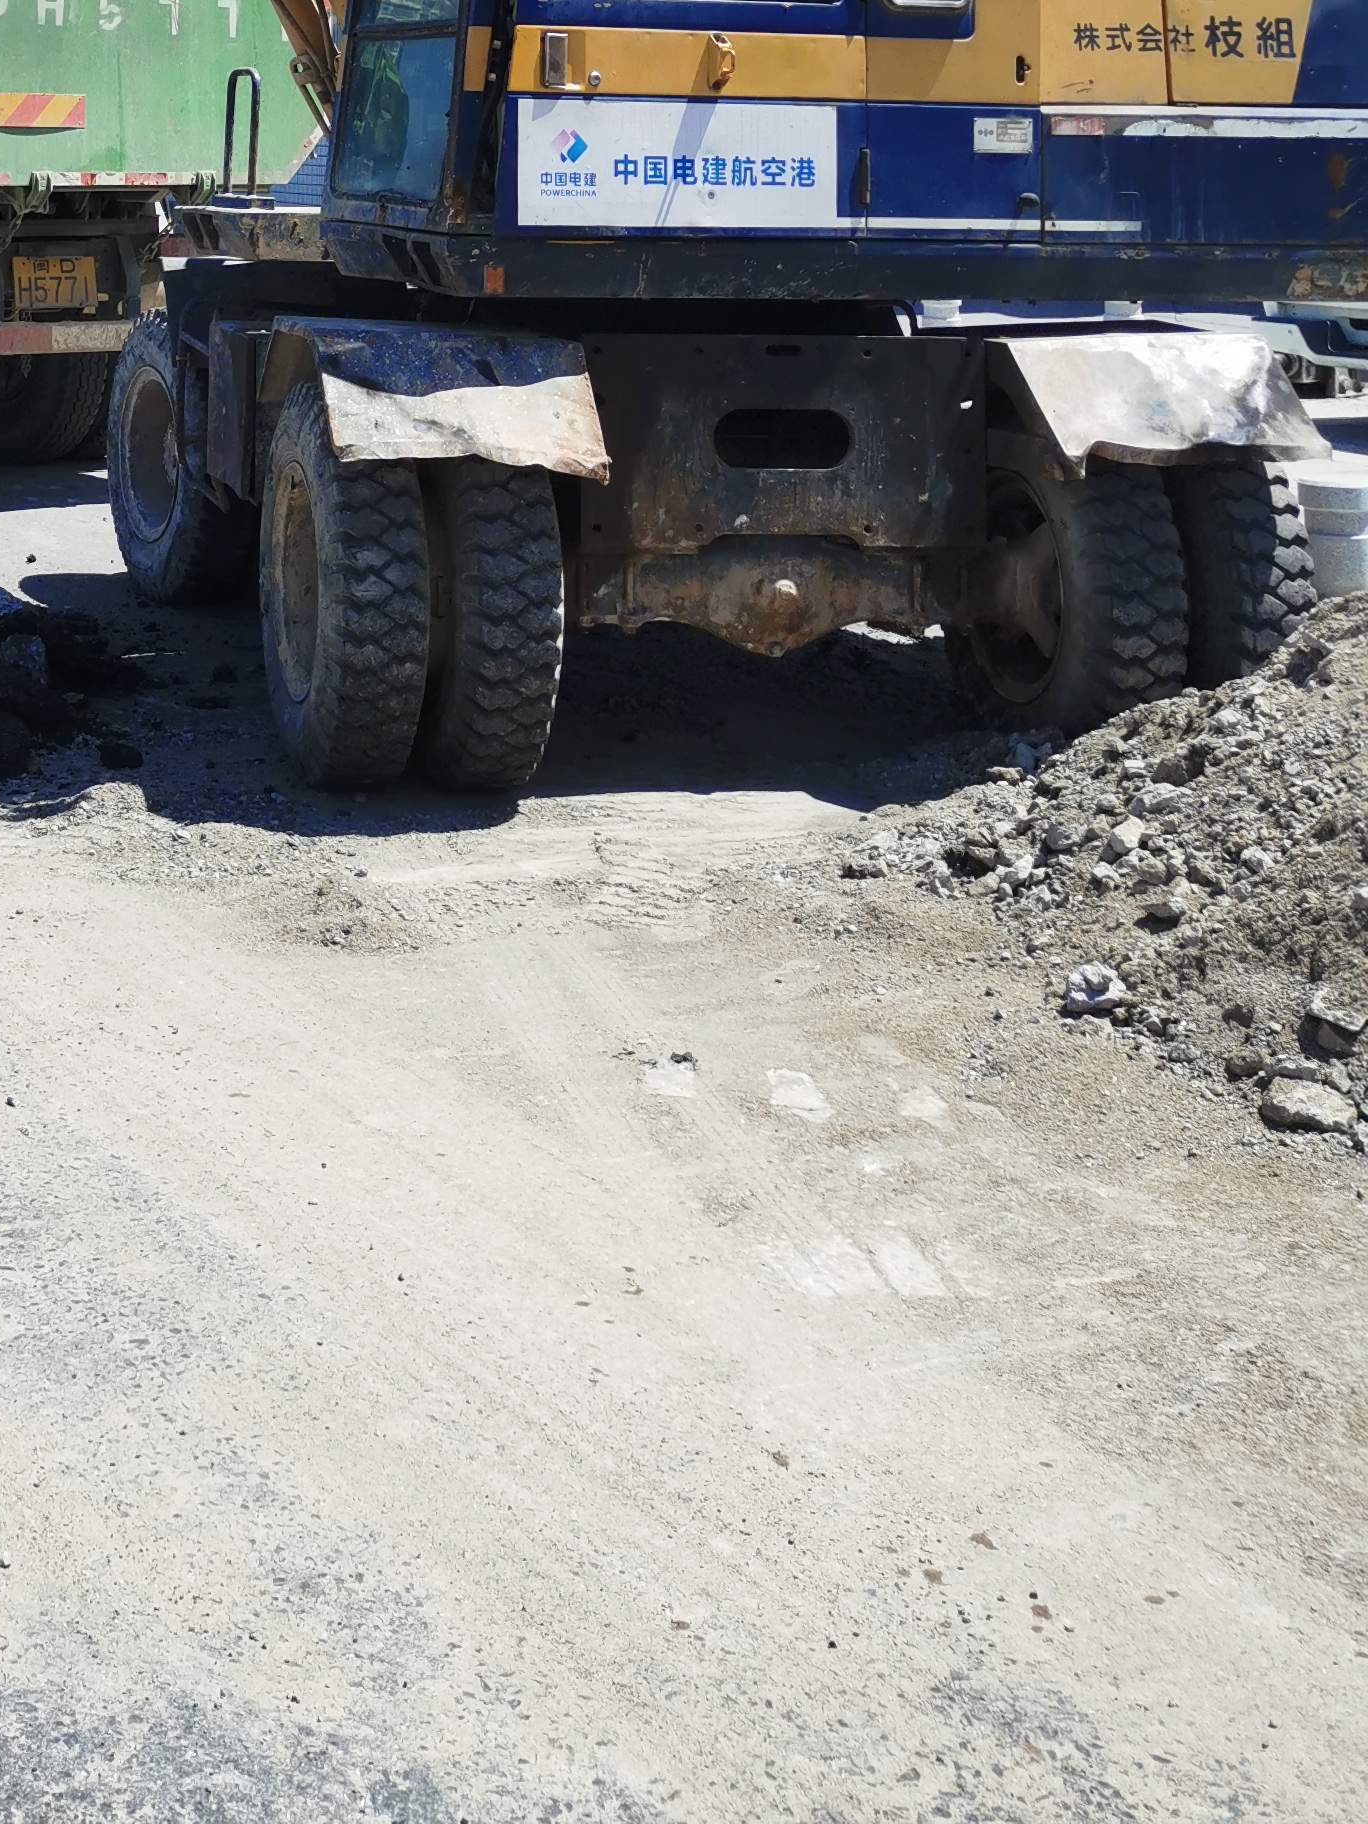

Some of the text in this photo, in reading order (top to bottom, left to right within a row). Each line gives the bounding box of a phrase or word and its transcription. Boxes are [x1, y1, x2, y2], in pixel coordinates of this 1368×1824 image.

[540, 171, 597, 186] 中国电建
[614, 154, 816, 188] 中国电建航空港
[540, 189, 597, 197] POWERCHINA
[18, 277, 89, 305] H5771
